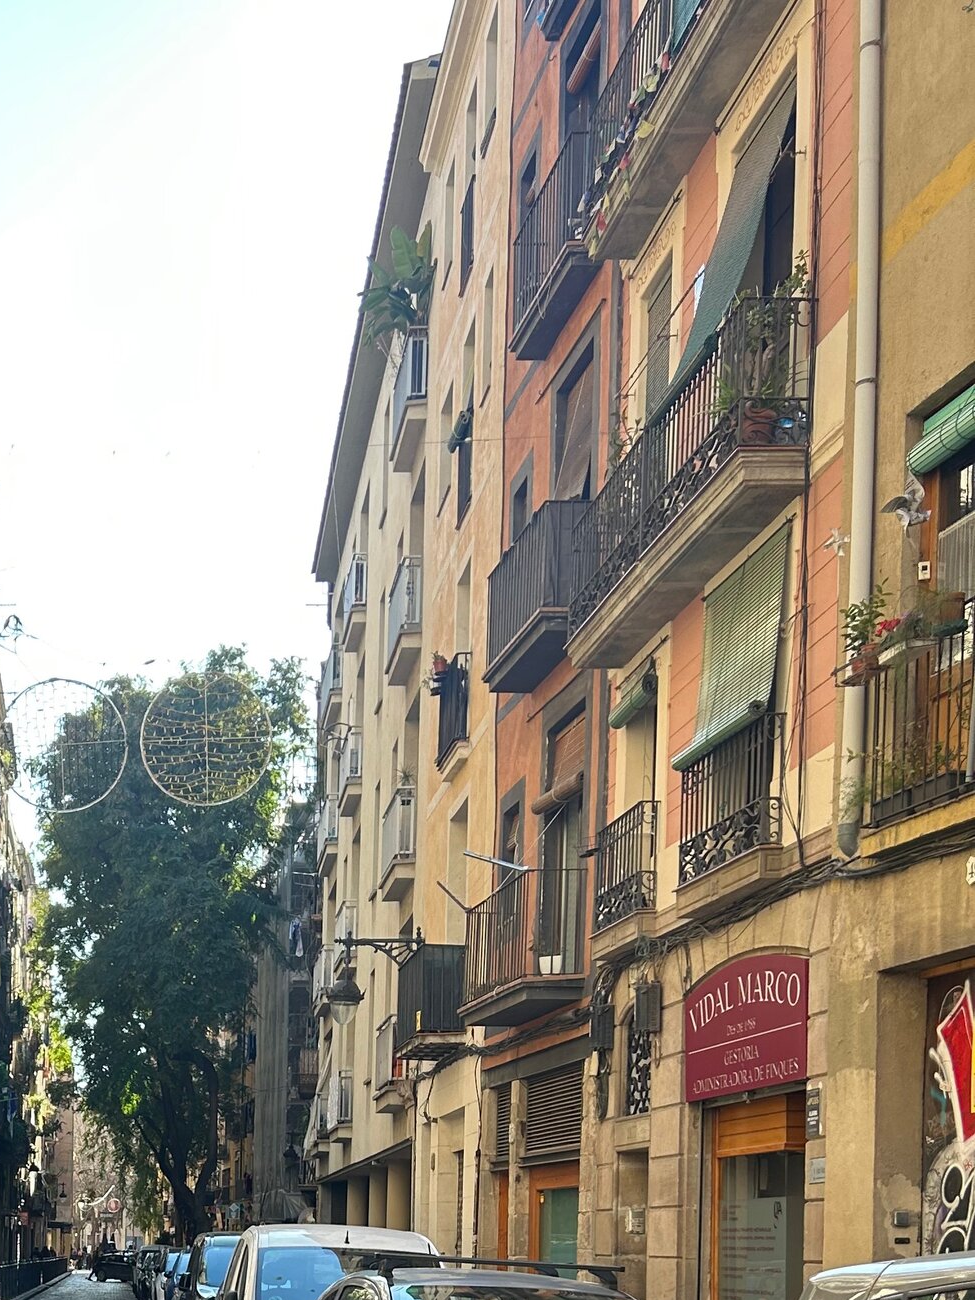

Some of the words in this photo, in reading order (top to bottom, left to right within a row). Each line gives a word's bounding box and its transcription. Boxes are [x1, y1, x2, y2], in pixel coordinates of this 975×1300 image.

[689, 981, 734, 1033] VIDAL
[738, 970, 801, 1007] MARCO
[693, 1068, 753, 1094] ADMINISTRADORA
[754, 1065, 764, 1082] DE
[765, 1057, 799, 1080] FINQUES
